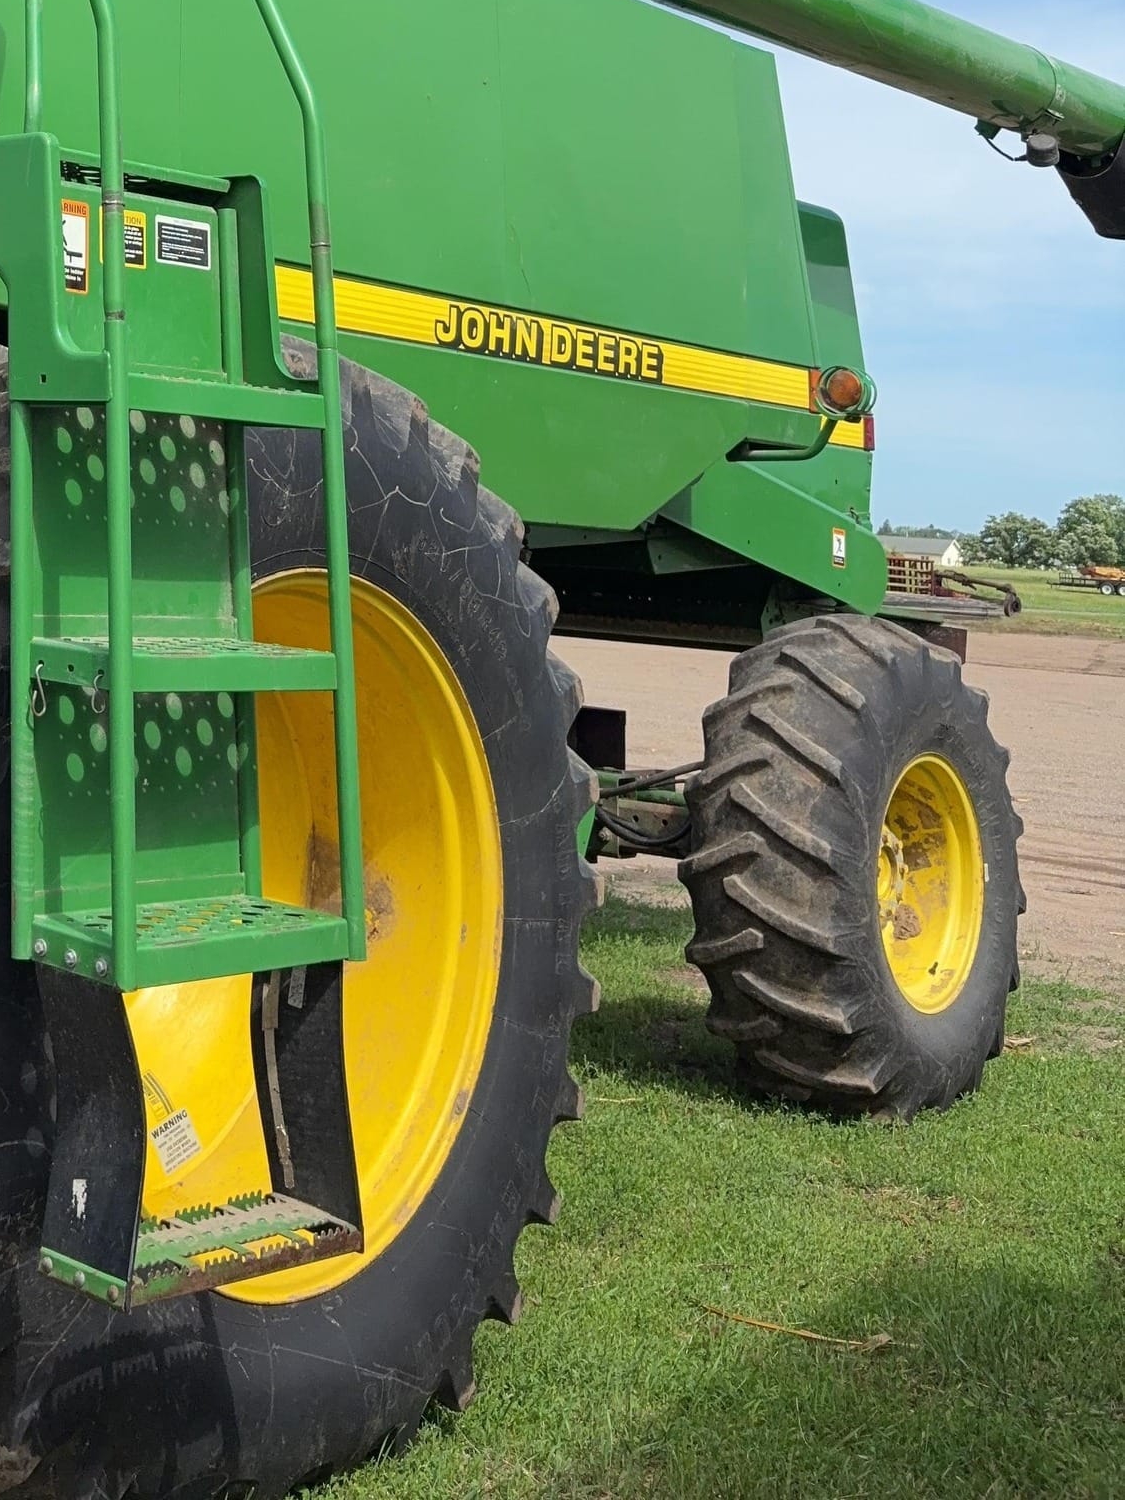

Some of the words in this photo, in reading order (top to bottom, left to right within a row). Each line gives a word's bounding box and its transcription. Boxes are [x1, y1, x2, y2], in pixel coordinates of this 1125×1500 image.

[64, 203, 87, 215] RNING
[126, 215, 142, 225] TION
[435, 304, 544, 359] JOHN
[549, 323, 664, 384] DEERE
[151, 1109, 188, 1139] WARNING
